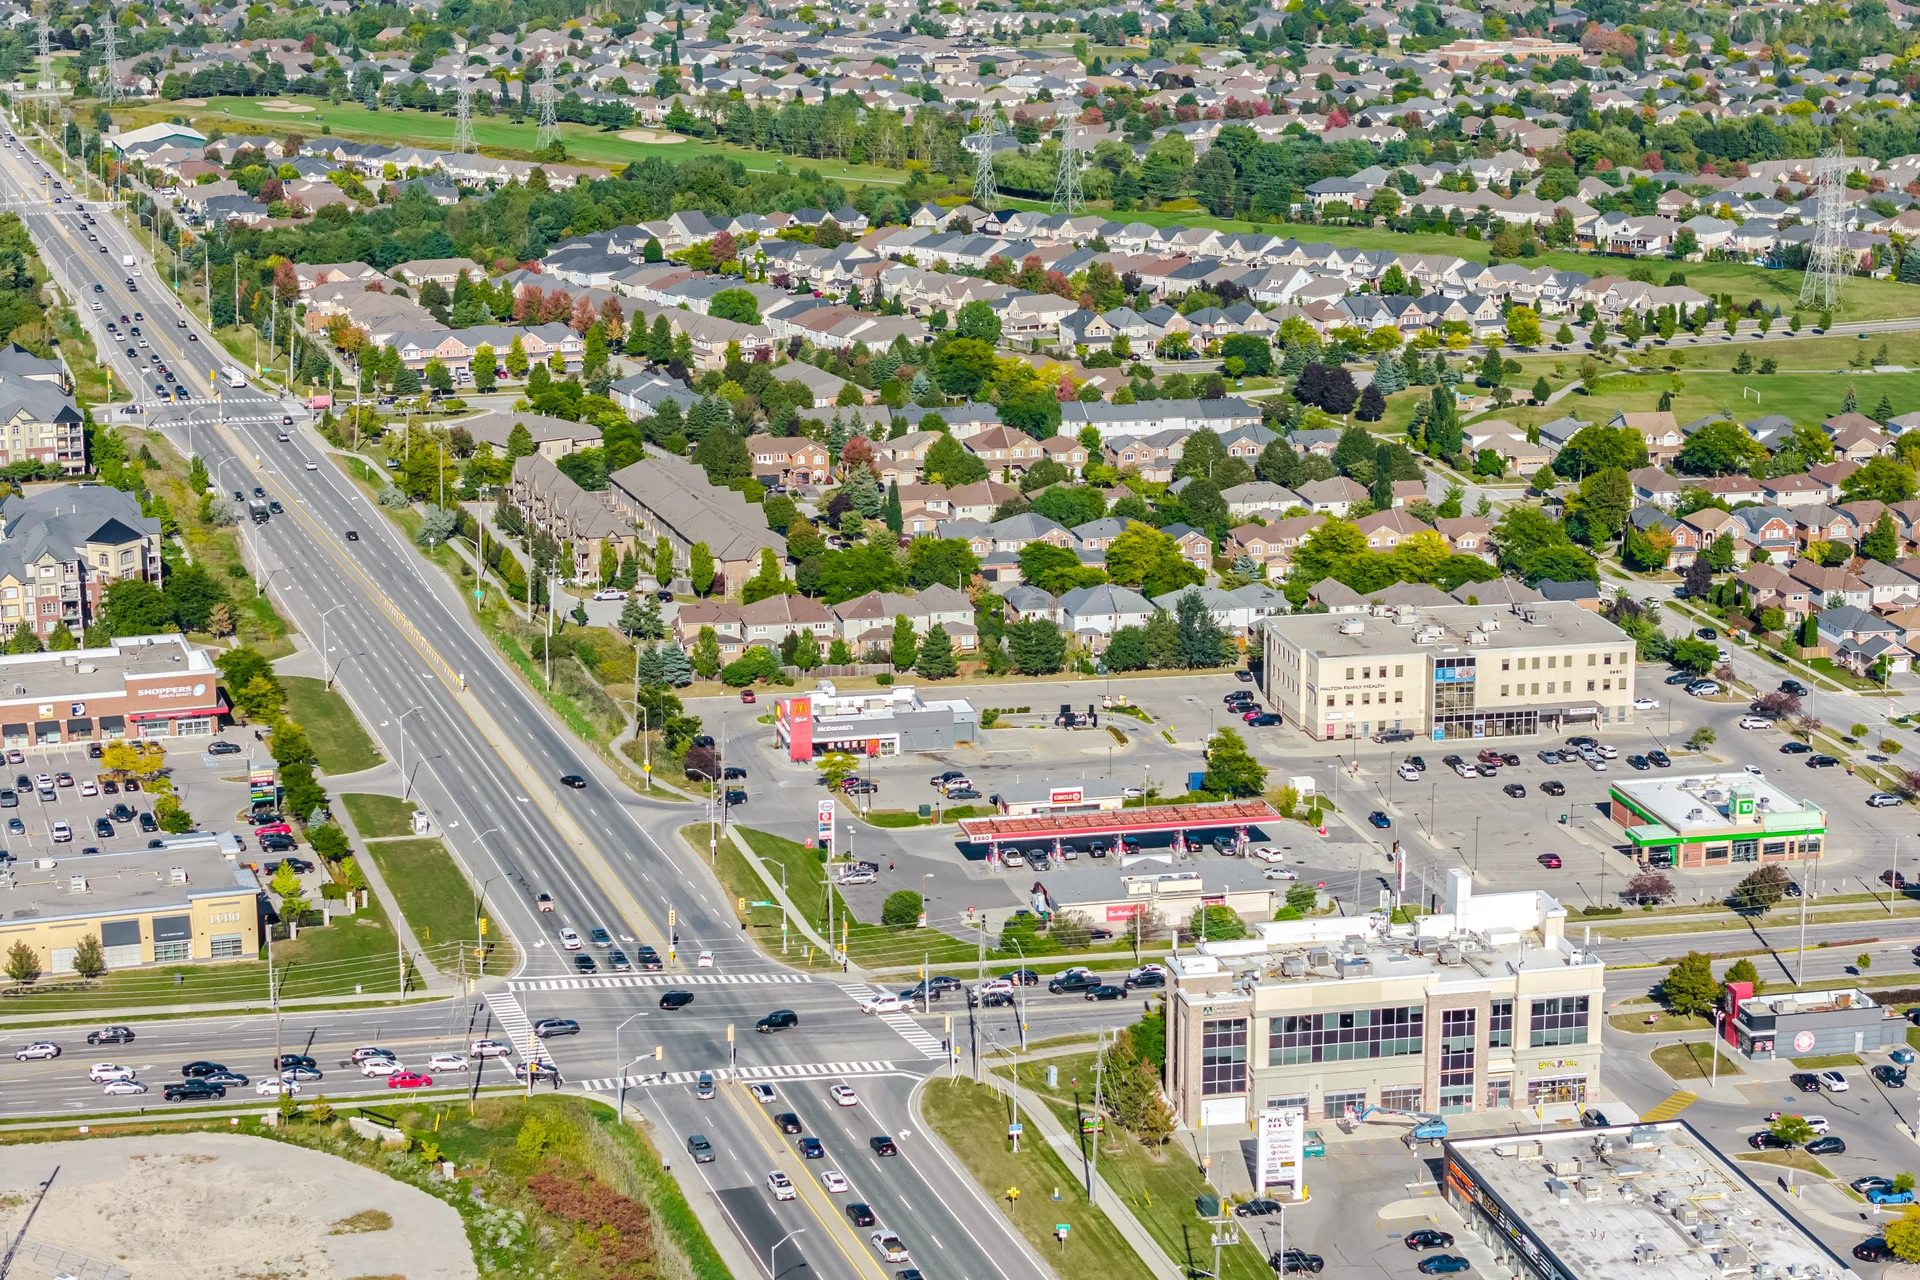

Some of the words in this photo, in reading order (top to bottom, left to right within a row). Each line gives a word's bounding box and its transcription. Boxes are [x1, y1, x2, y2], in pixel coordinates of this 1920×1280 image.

[137, 686, 192, 696] SHOPPERS
[817, 724, 854, 732] McDonald's
[1741, 803, 1753, 812] TD
[210, 912, 240, 924] LCBO
